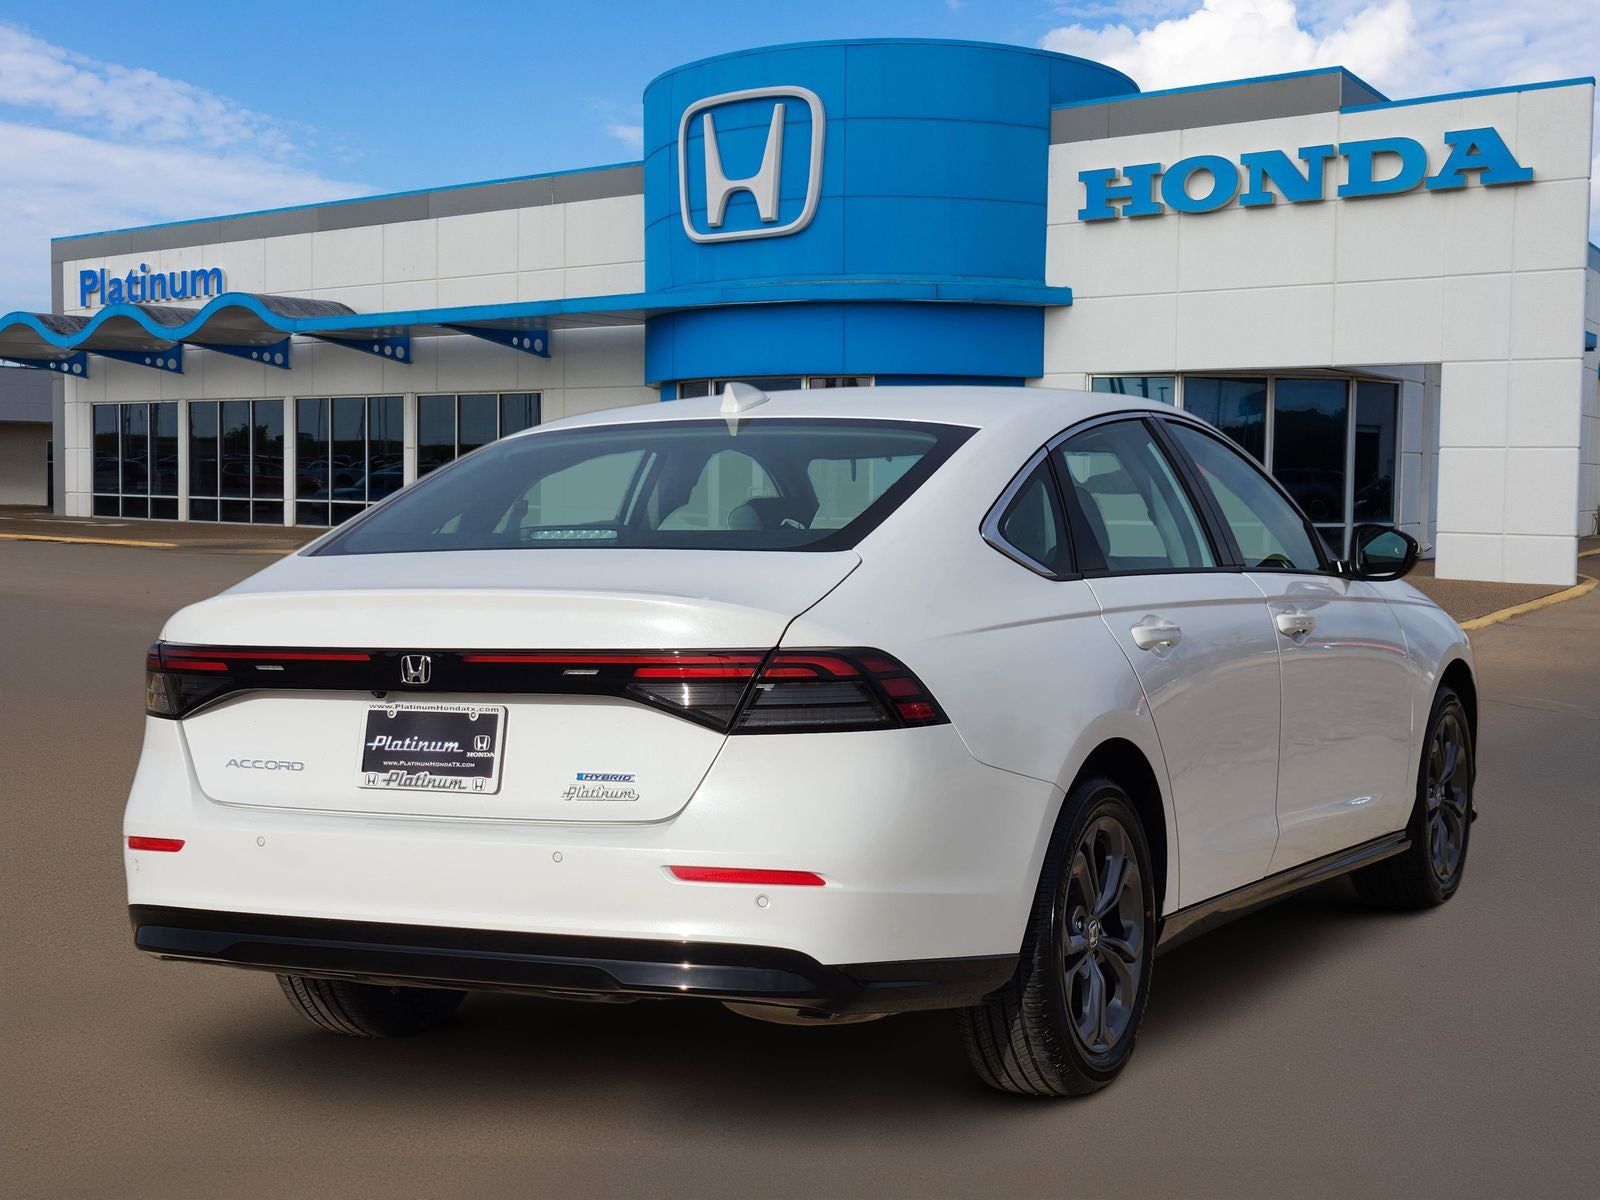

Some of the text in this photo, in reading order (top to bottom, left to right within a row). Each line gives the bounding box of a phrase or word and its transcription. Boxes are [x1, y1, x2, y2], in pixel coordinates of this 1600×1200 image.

[1078, 126, 1534, 221] HONDA
[79, 263, 227, 308] Platinum
[366, 735, 464, 753] Platinum
[225, 758, 305, 771] ACCORD
[382, 772, 468, 790] Platinum
[580, 773, 635, 782] HYBRID
[562, 785, 640, 801] Platinum
